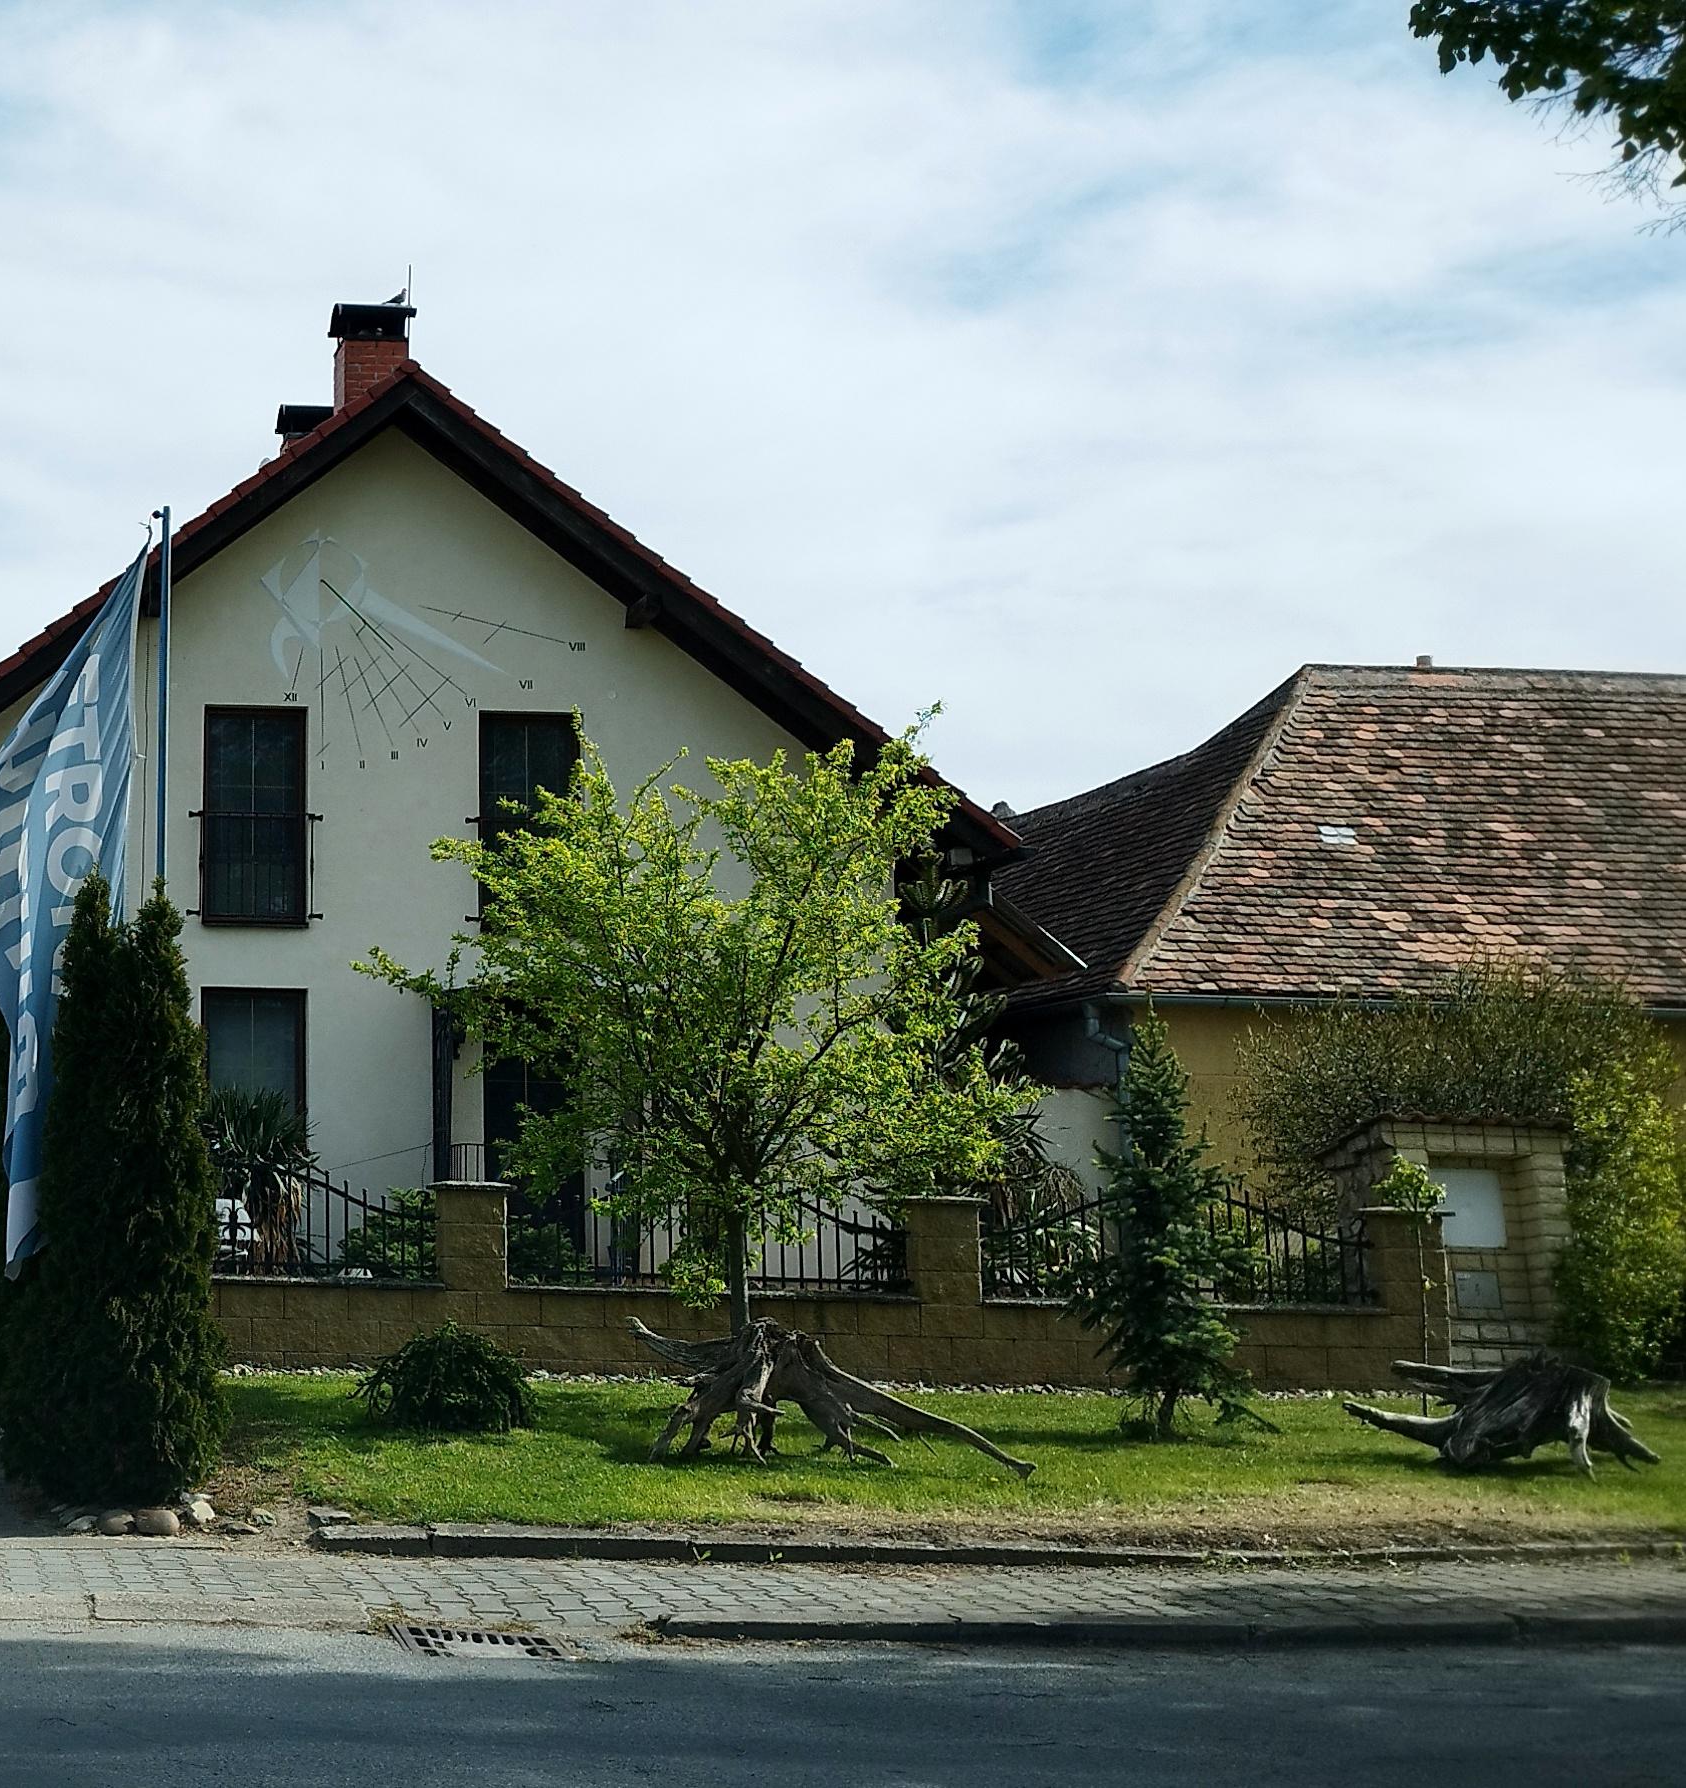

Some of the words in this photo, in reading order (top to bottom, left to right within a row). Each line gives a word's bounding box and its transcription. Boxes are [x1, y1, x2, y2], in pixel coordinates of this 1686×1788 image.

[568, 641, 586, 652] VIII
[518, 679, 534, 690] VII
[282, 692, 298, 702] XII
[464, 697, 477, 709] VI
[442, 720, 452, 731] V
[416, 737, 429, 748] IV
[390, 750, 399, 761] III
[358, 759, 366, 770] II
